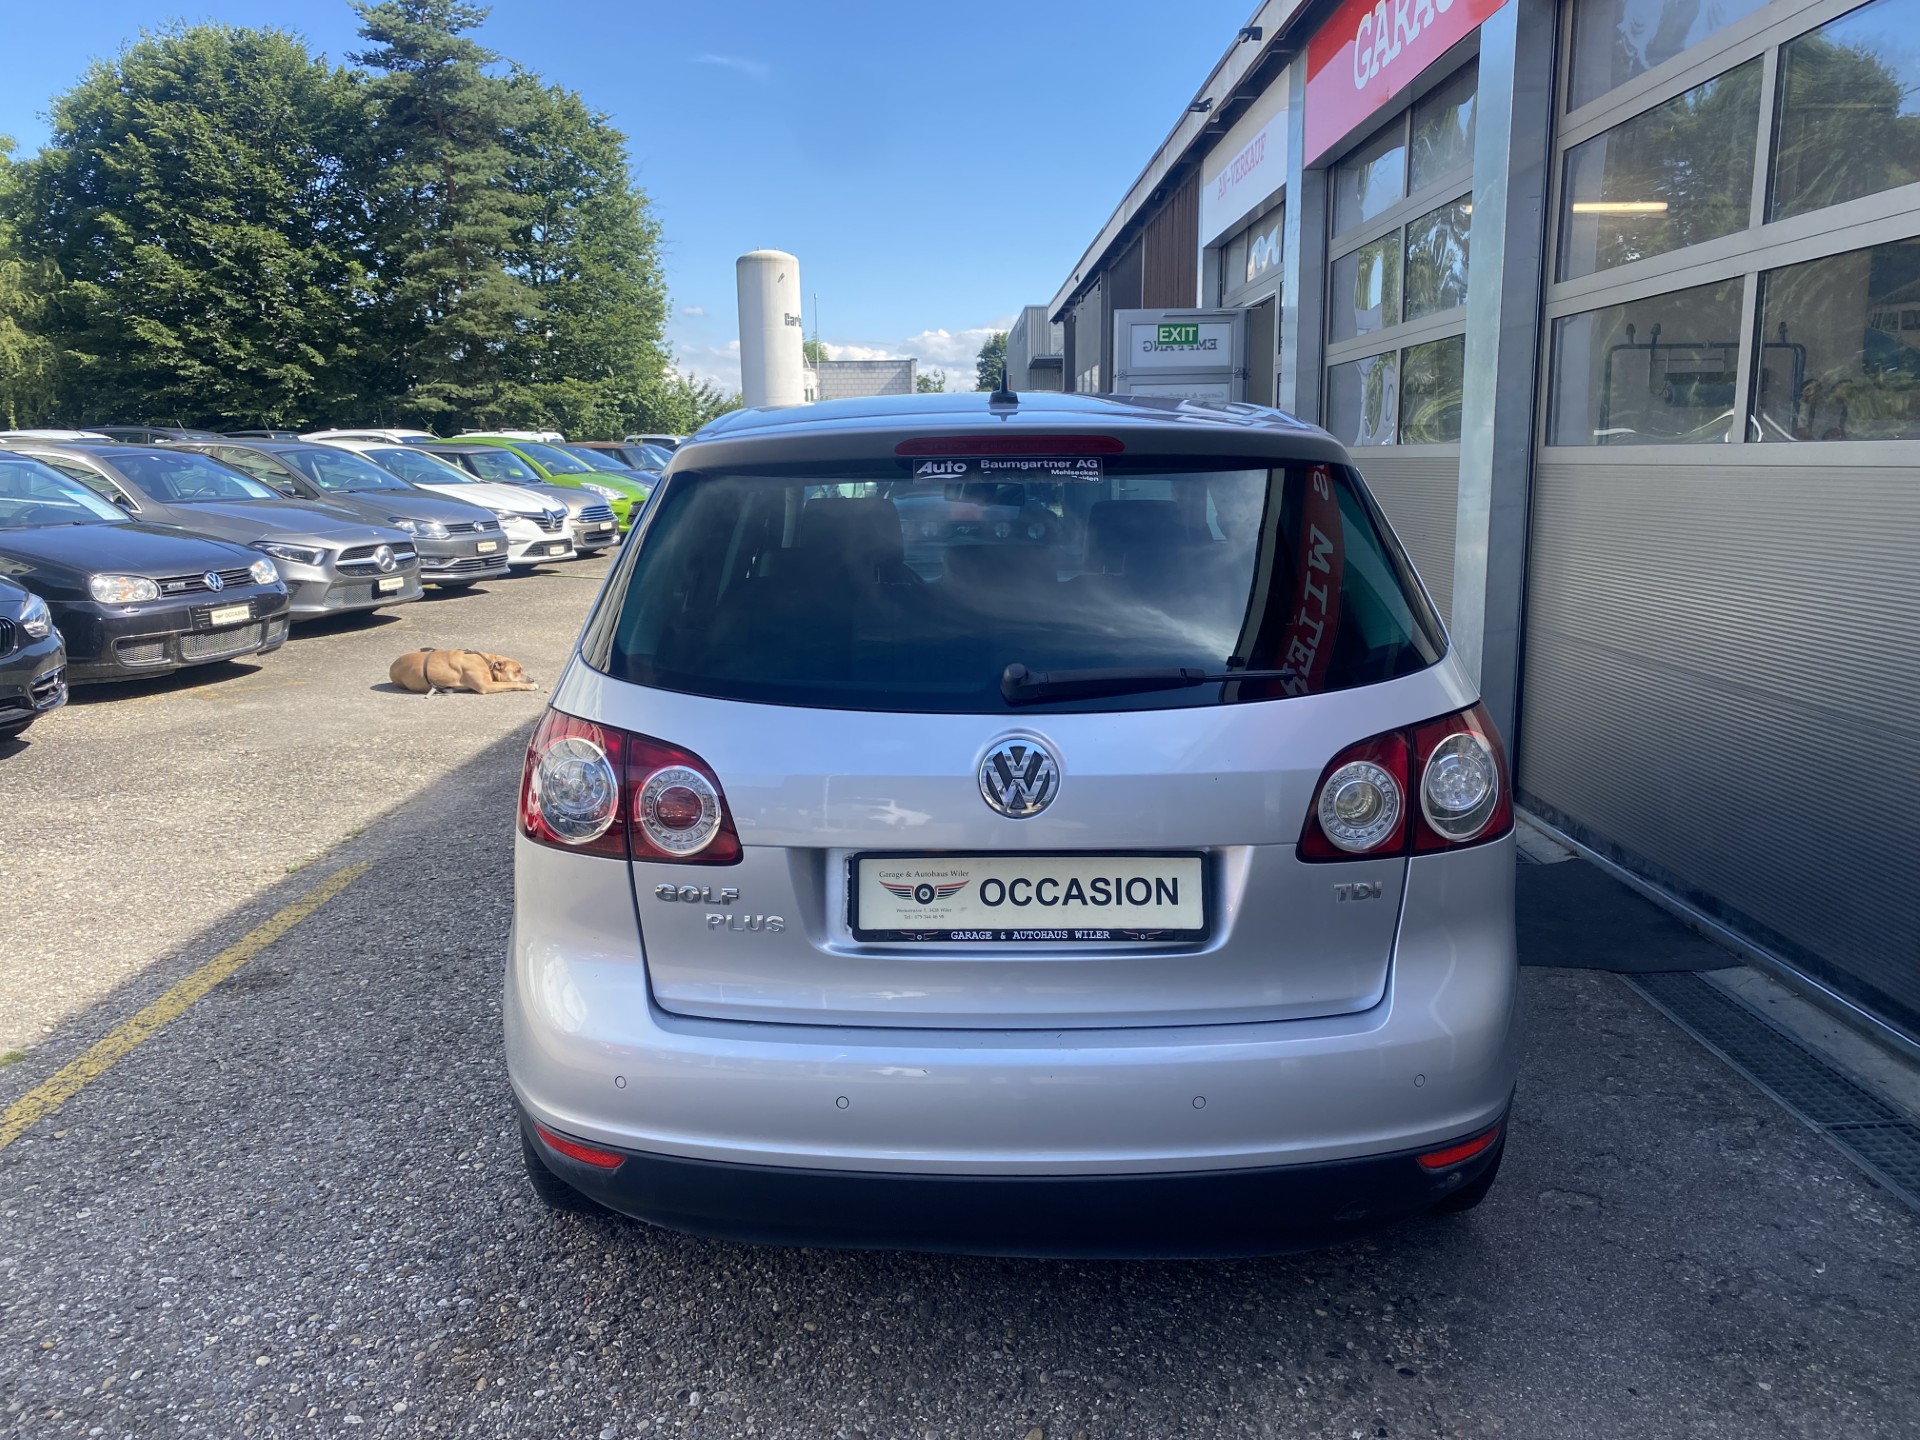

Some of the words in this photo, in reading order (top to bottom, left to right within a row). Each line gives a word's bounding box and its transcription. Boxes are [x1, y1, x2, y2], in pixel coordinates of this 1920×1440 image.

[1159, 327, 1197, 342] EXIT
[916, 460, 967, 474] Auto
[980, 459, 1072, 470] Baumgartner
[1076, 459, 1098, 469] AG
[878, 870, 904, 879] Garage
[905, 870, 912, 878] &
[914, 870, 949, 878] Autohaus
[950, 869, 970, 878] Wiler
[655, 883, 740, 905] GOLF
[979, 876, 1179, 907] OCCASION
[1333, 881, 1382, 902] TDI
[706, 912, 786, 933] PLUS
[950, 931, 993, 940] GARAGE
[1000, 931, 1007, 940] &
[1012, 930, 1068, 940] AUTOHAUS
[1074, 930, 1111, 939] WILER
